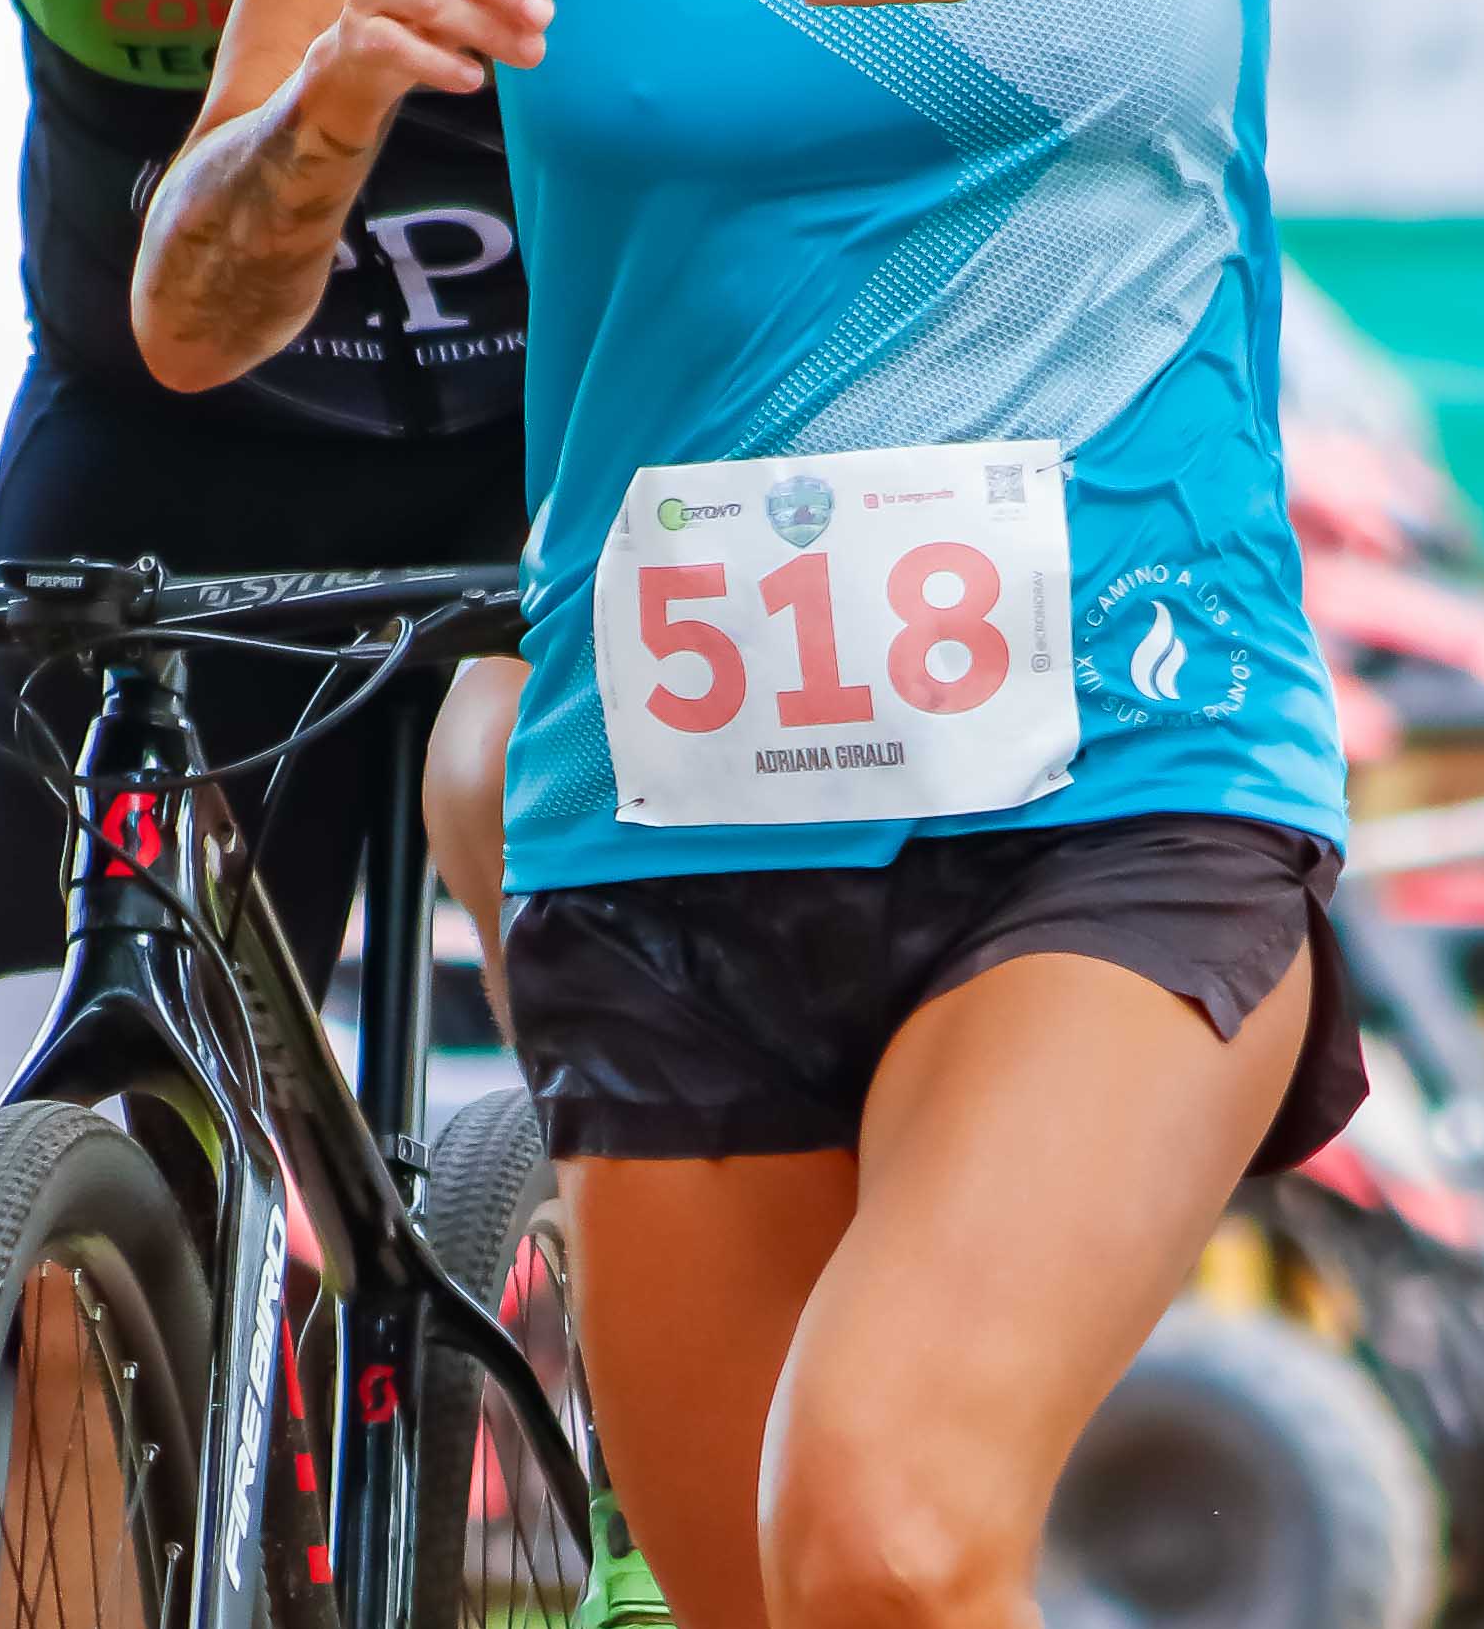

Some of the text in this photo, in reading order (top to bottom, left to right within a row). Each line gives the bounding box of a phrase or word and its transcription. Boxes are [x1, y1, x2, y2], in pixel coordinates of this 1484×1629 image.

[638, 541, 1010, 734] 518
[1086, 564, 1231, 627] CAMINO A LOS
[756, 741, 905, 774] ADRIANA GIRALDI
[226, 1202, 287, 1592] FIREBIRD
